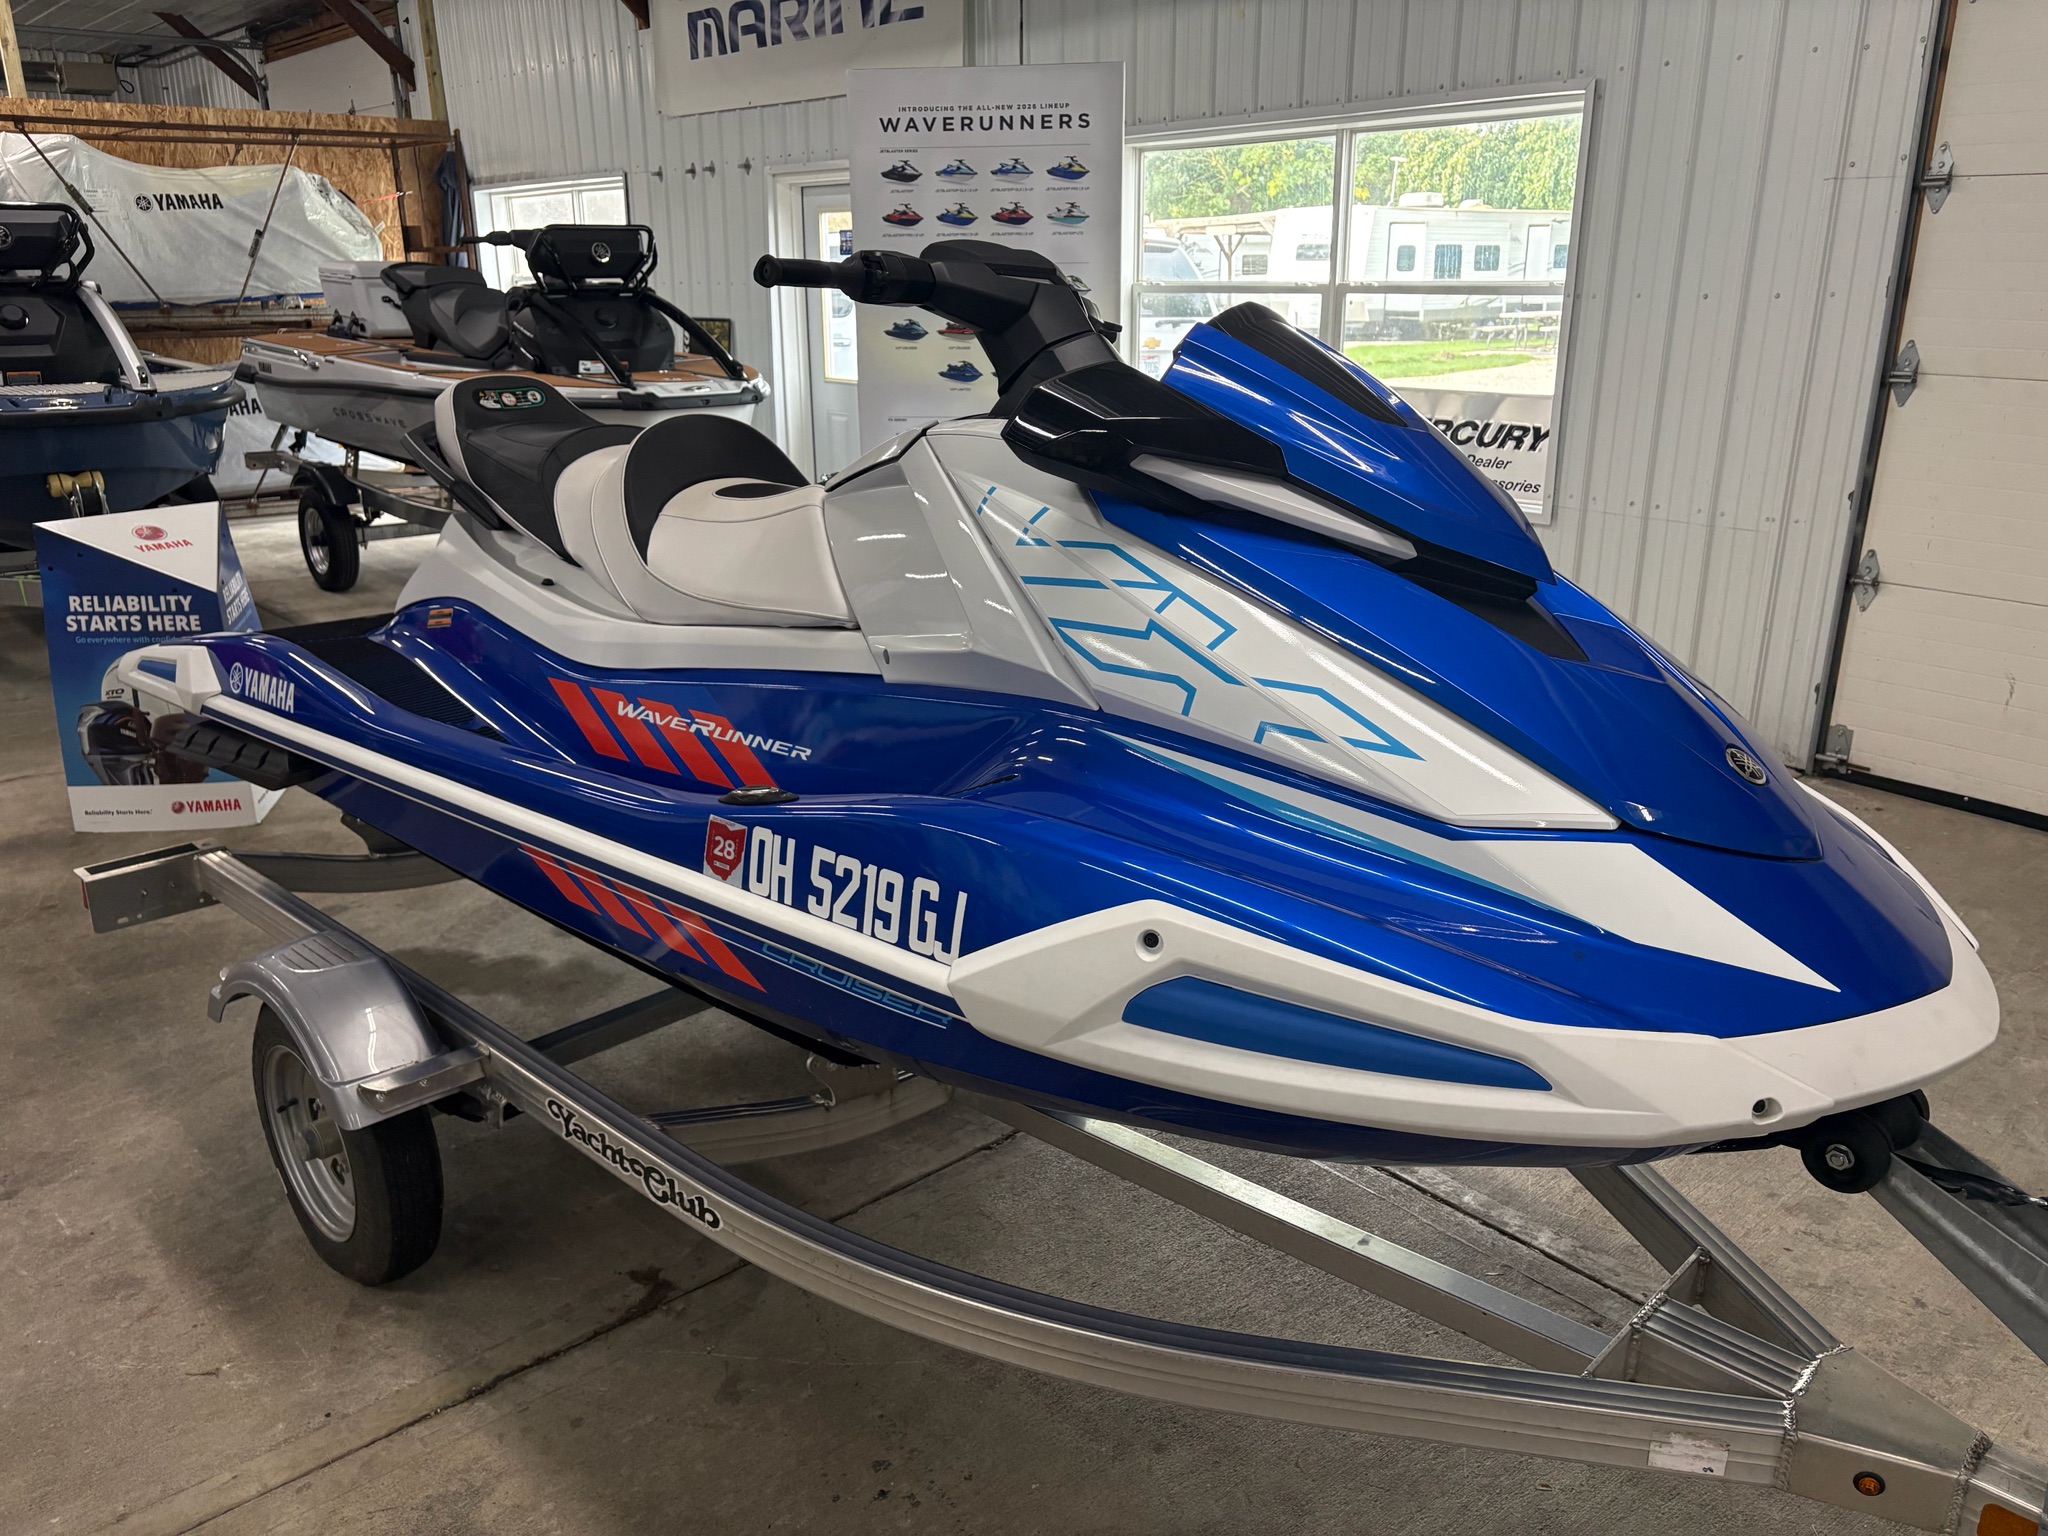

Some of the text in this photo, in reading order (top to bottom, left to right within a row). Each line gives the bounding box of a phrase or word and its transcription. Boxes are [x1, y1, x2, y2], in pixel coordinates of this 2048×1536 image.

[898, 105, 955, 113] INTRODUCING
[976, 103, 1014, 111] ALL-NEW
[1039, 102, 1071, 110] LINEUP
[879, 113, 1090, 133] WAVERUNNERS
[152, 193, 224, 211] YAMAHA
[229, 397, 262, 416] AHA
[333, 406, 407, 428] CROSSWAVE
[1431, 418, 1550, 452] RCURY
[134, 539, 193, 553] YAMAHA
[68, 595, 193, 613] RELIABILITY
[66, 614, 202, 632] STARTS HERE
[75, 636, 87, 644] Go
[87, 636, 131, 646] everywhere
[132, 636, 150, 644] with
[105, 688, 125, 696] XTO
[244, 667, 295, 714] YAMAHA
[186, 798, 242, 813] YAMAHA
[713, 835, 735, 860] 28
[748, 825, 968, 967] OH 5219 GJ
[762, 942, 953, 1025] CRUISER
